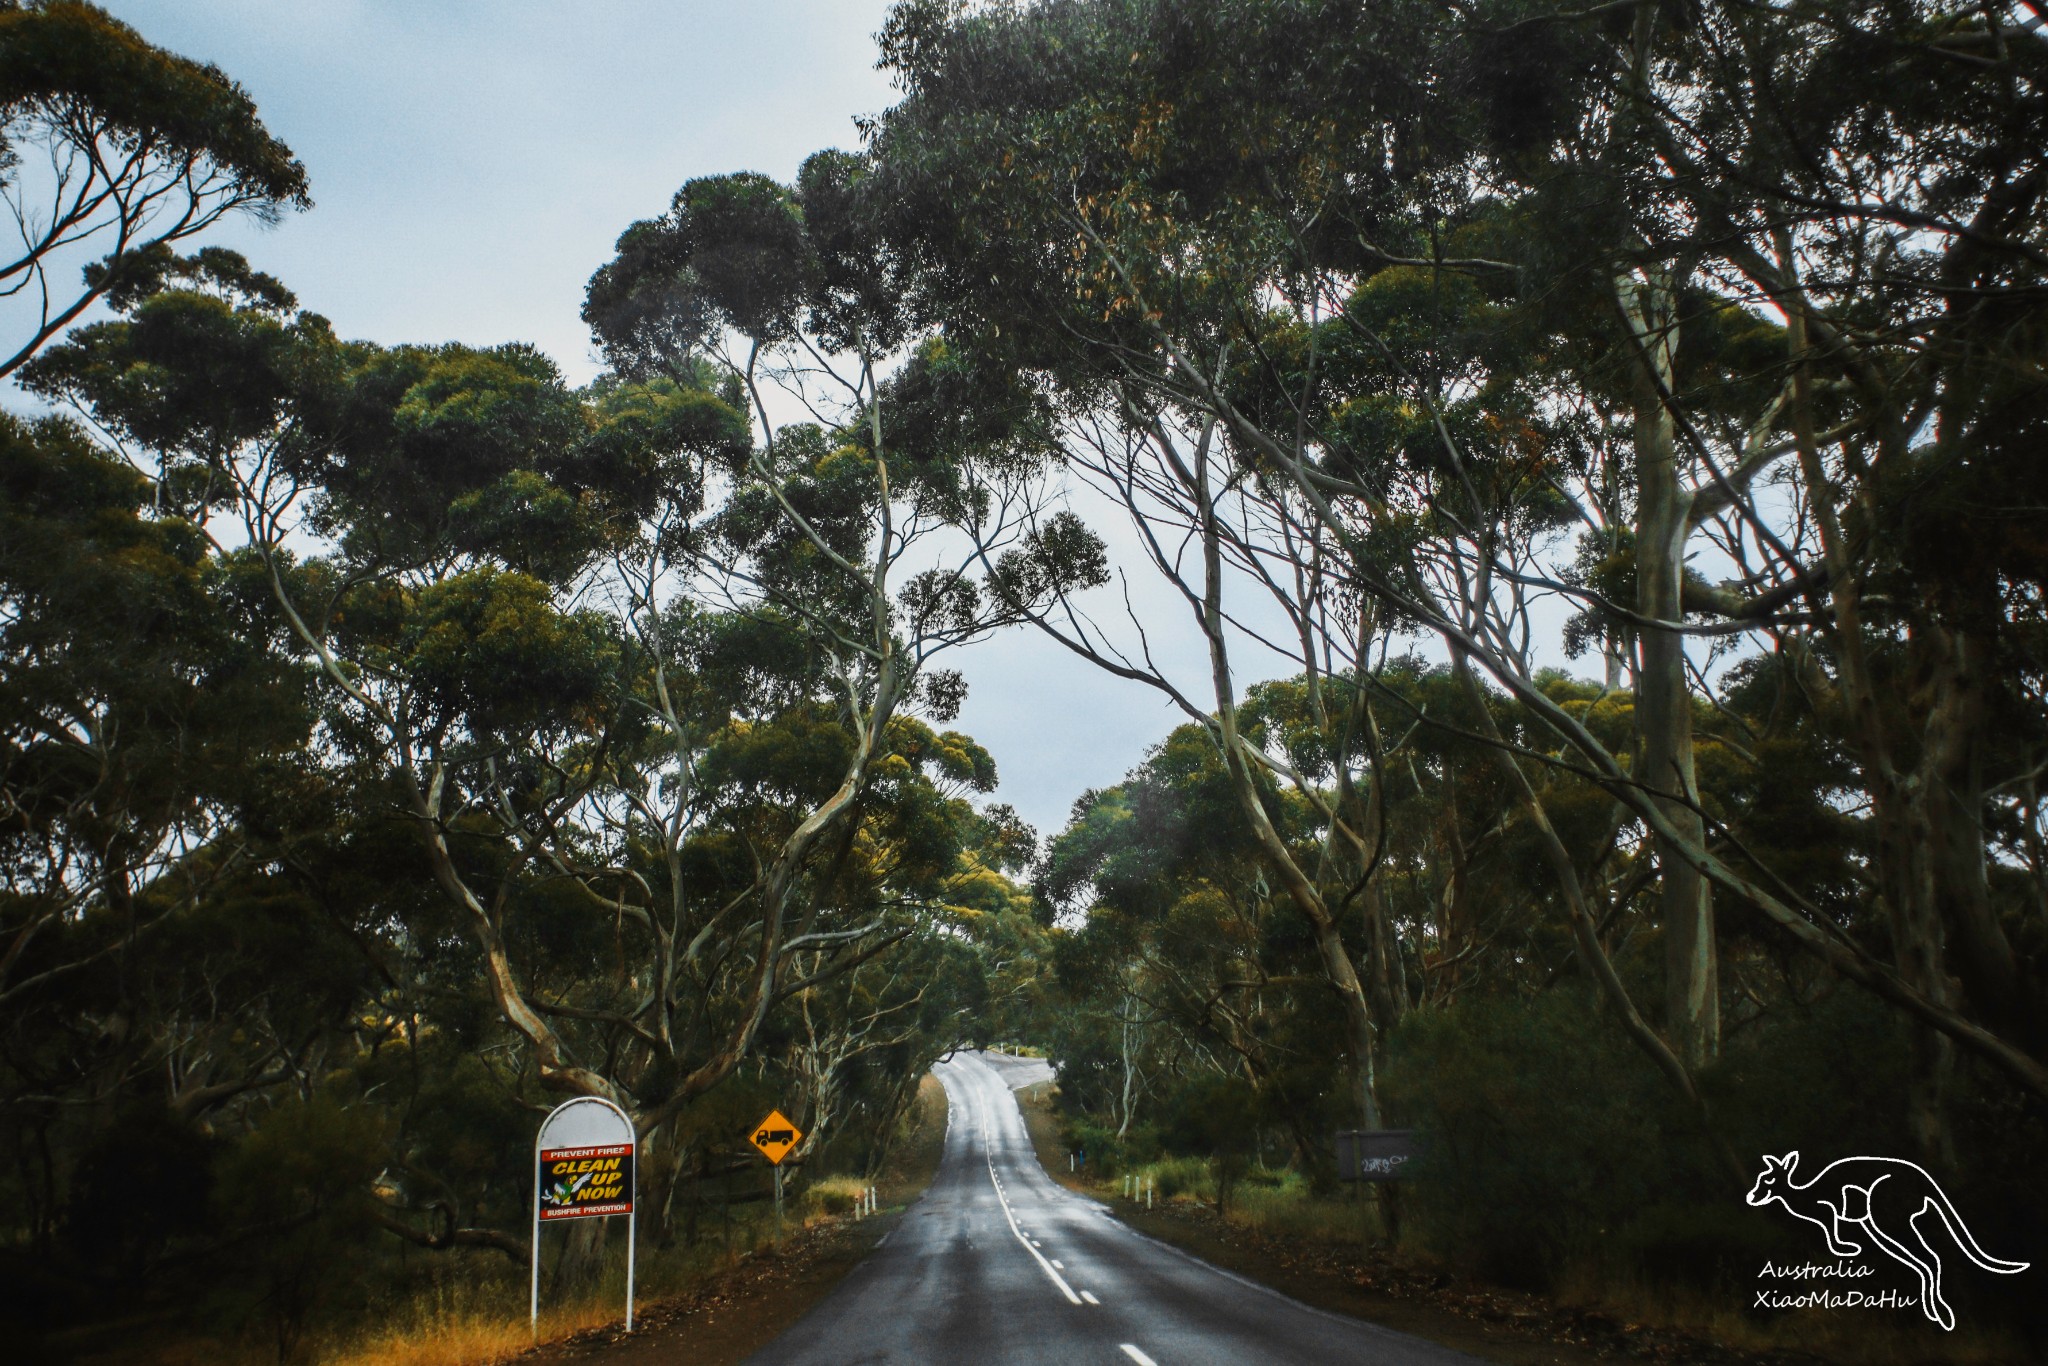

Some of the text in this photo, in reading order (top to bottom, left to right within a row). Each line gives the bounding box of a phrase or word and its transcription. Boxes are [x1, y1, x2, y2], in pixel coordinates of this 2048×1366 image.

[551, 1149, 595, 1158] PREVENT
[552, 1158, 621, 1174] CLEAN
[591, 1173, 622, 1185] UP
[577, 1186, 622, 1201] NOW
[547, 1204, 626, 1216] BUSHFIRE PREVENTION
